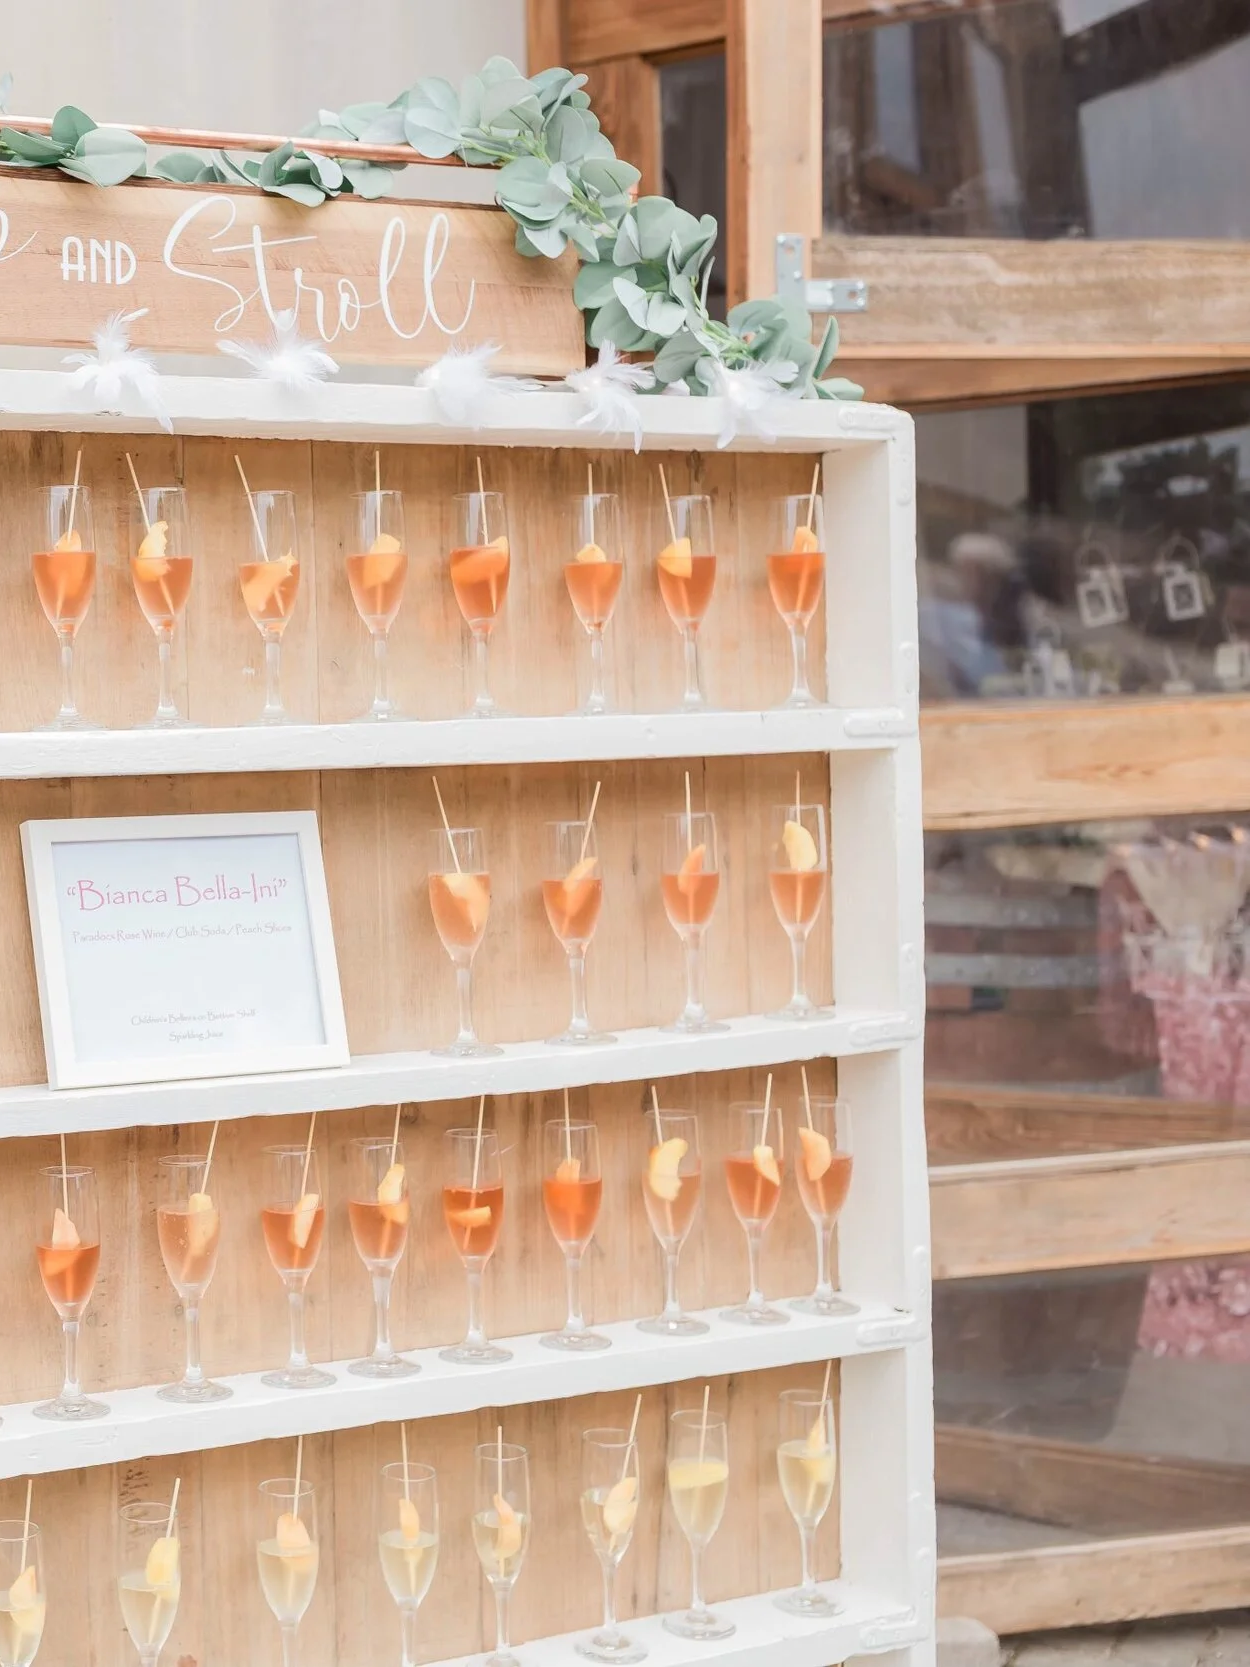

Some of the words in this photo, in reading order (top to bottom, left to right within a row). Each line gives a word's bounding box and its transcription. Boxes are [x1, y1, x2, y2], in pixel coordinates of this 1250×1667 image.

[60, 235, 138, 285] AND
[163, 195, 476, 342] Stroll
[141, 928, 165, 940] Wine
[175, 925, 198, 938] Club
[200, 924, 226, 938] Soda
[235, 922, 263, 936] Peach
